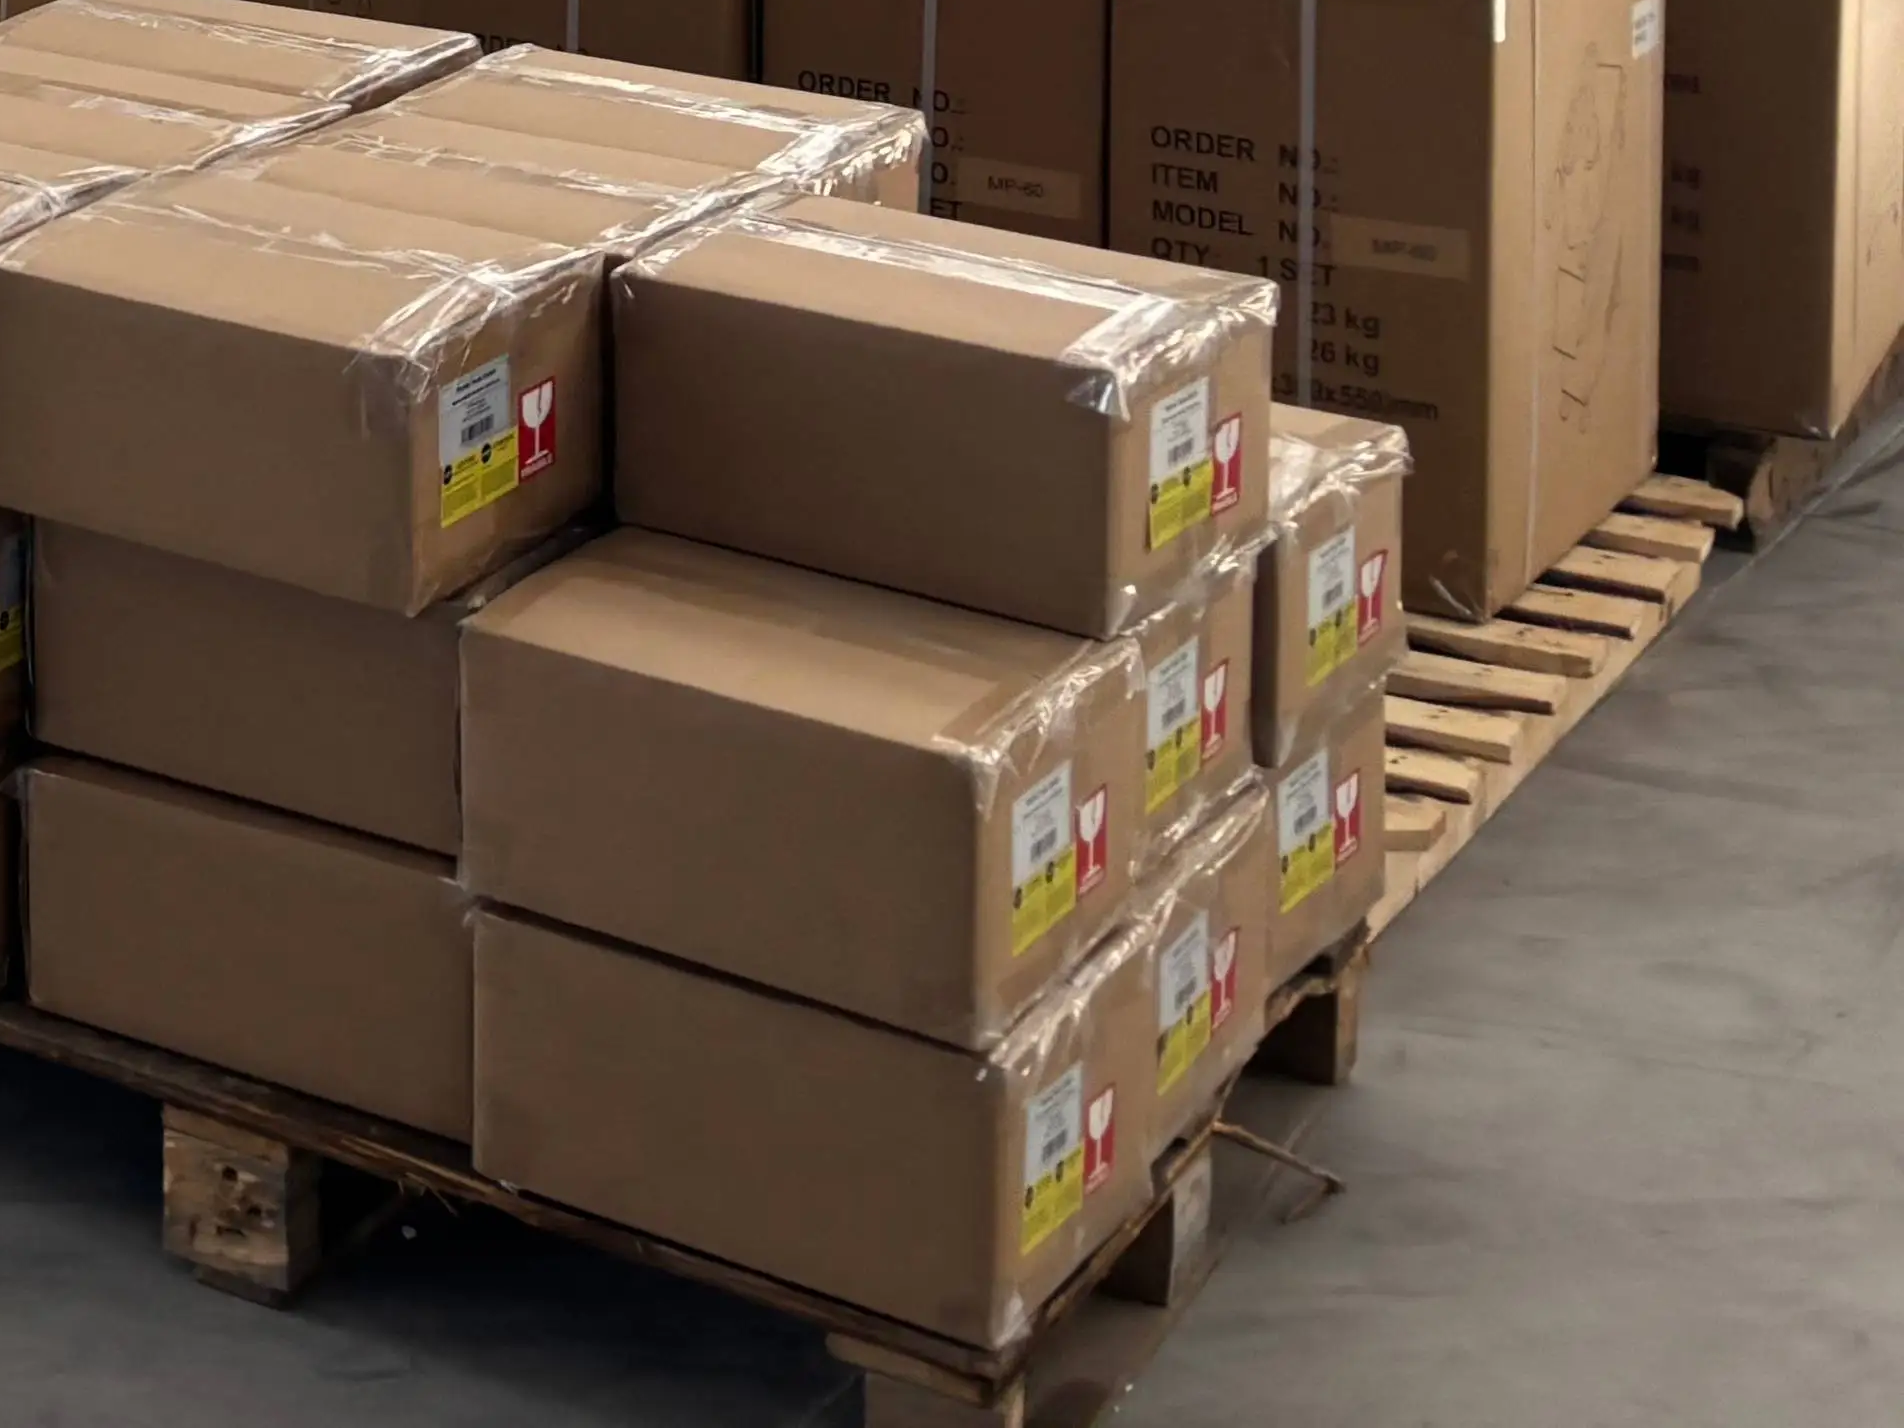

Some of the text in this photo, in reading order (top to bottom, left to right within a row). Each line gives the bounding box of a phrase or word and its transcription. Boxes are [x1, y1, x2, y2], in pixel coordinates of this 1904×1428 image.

[798, 70, 891, 104] ORDER
[1151, 126, 1255, 161] ORDER
[1152, 164, 1218, 193] ITEM
[1152, 200, 1254, 236] MODEL
[1345, 307, 1379, 339] kg
[1345, 344, 1379, 376] kg
